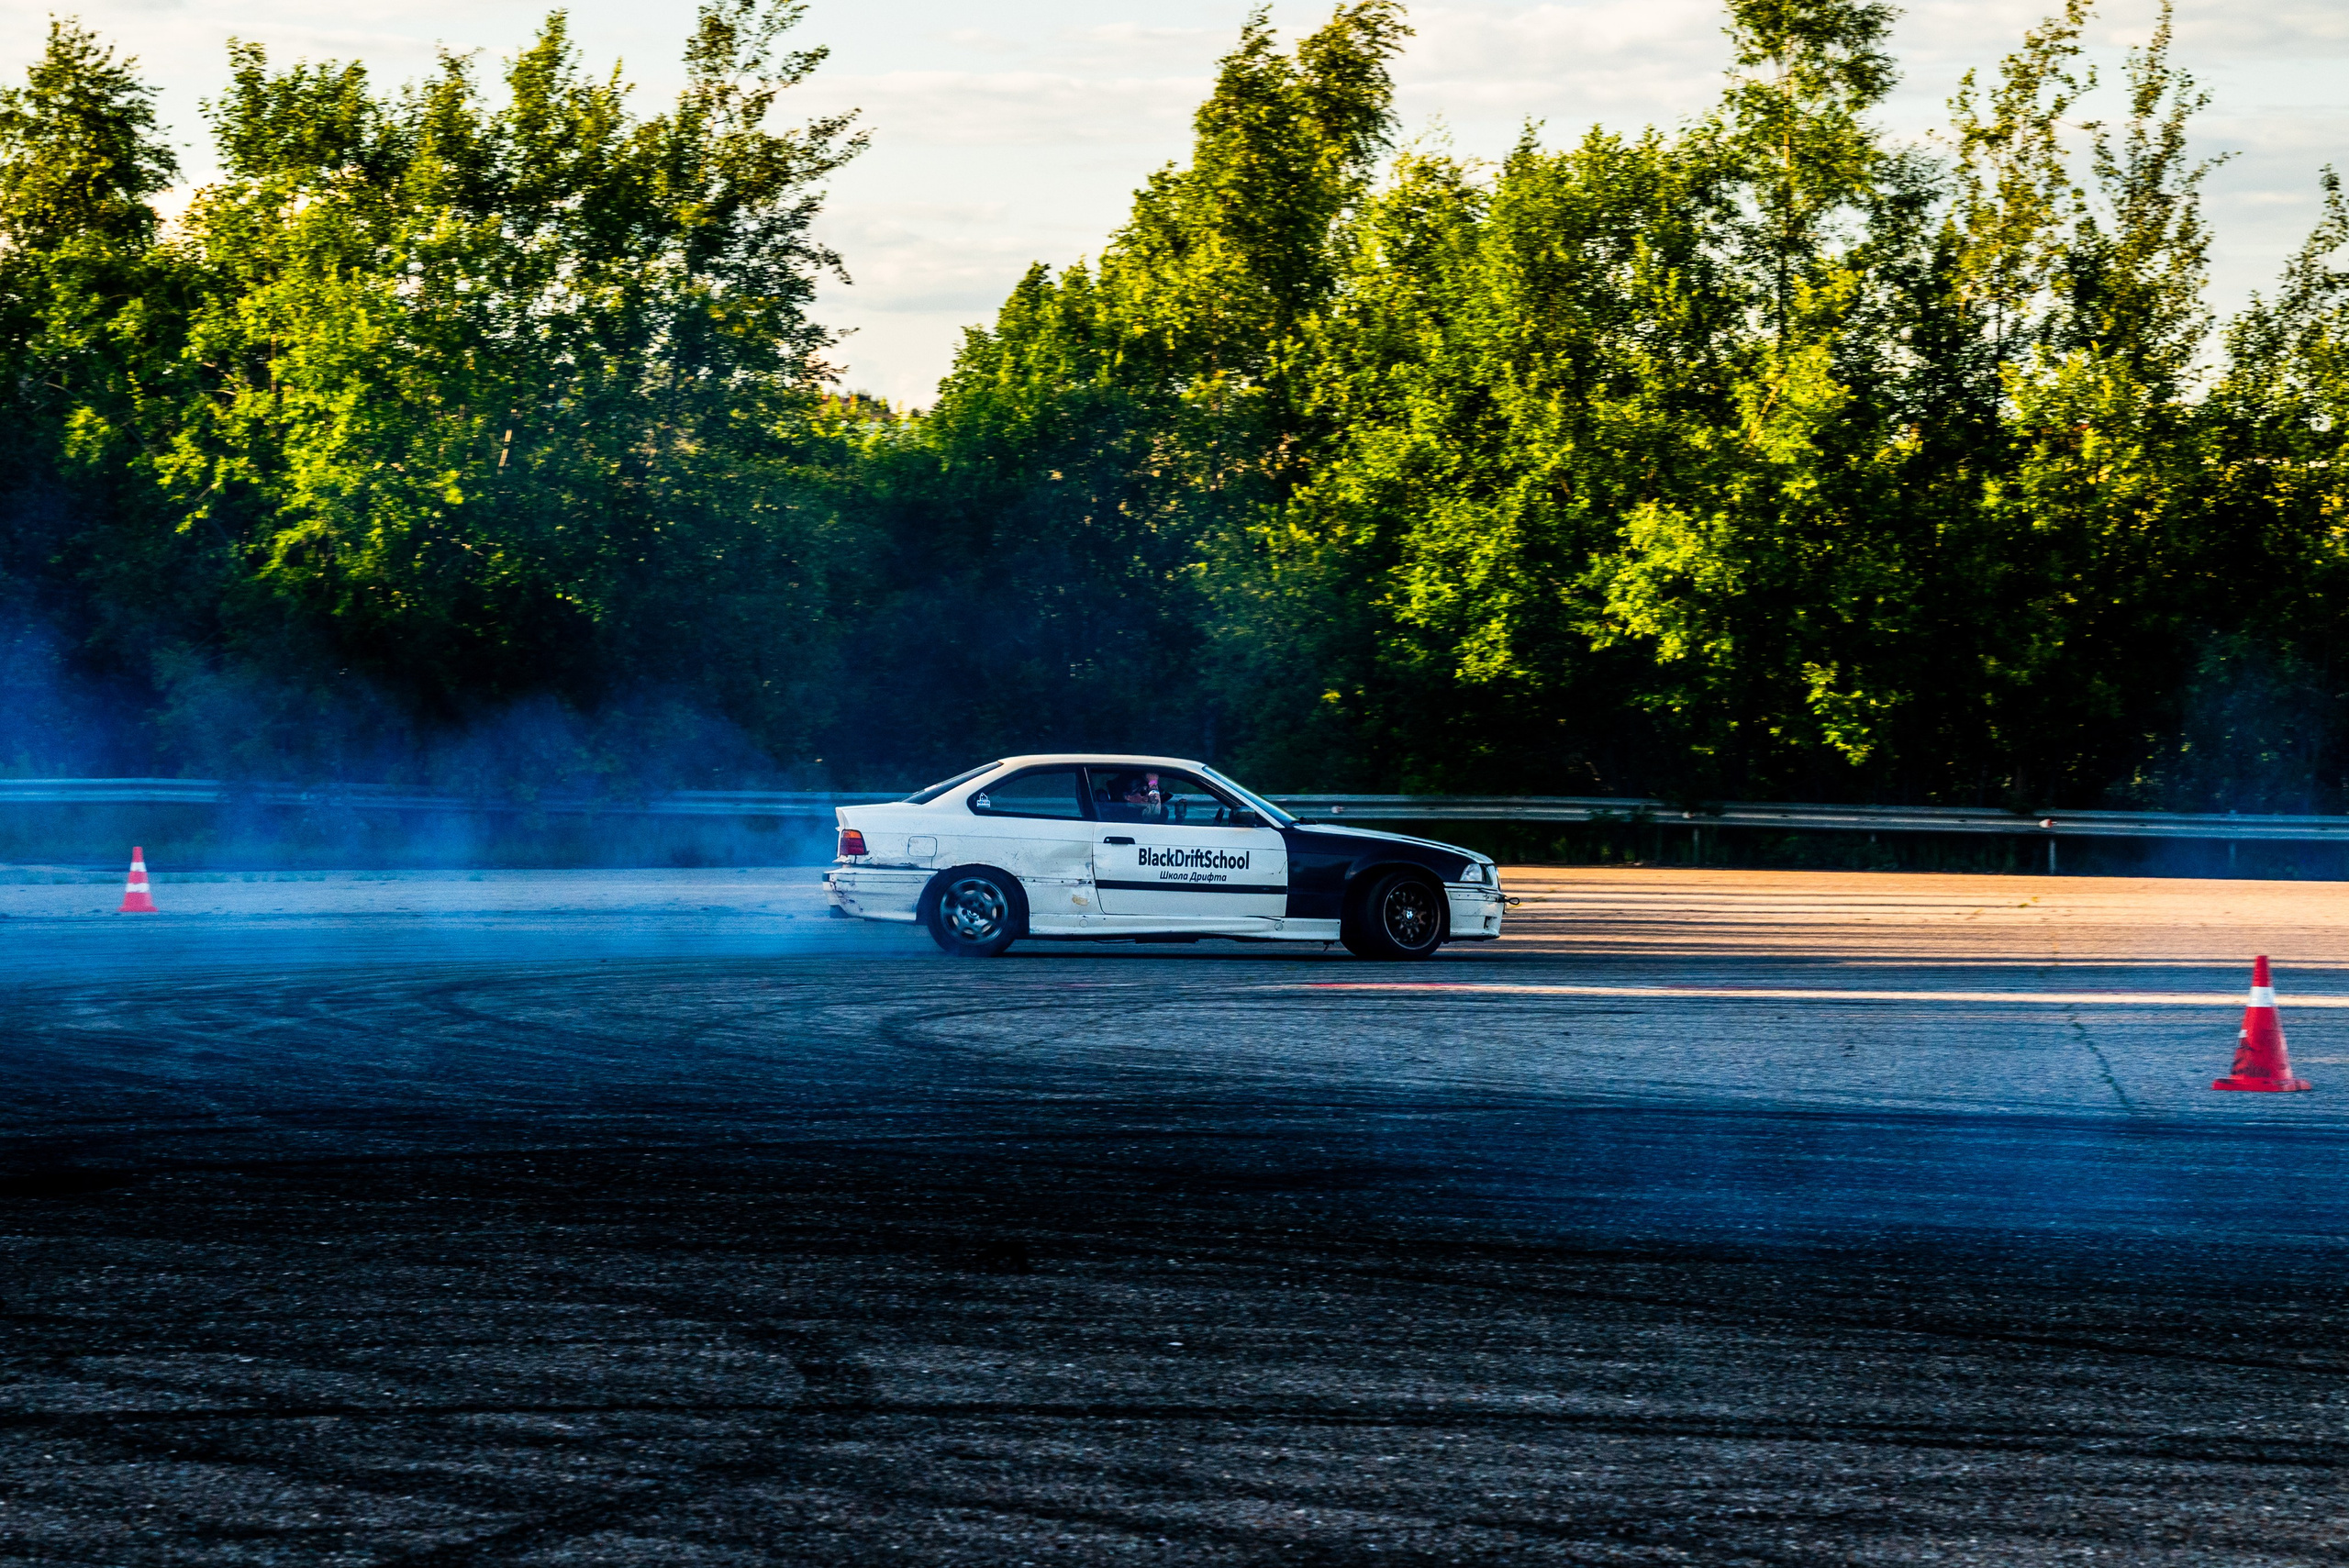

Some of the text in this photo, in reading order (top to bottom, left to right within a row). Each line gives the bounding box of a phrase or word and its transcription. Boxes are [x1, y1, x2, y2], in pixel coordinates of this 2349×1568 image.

[1139, 847, 1250, 870] BlackDriftSchool
[1160, 871, 1227, 883] Школа Дрифта
